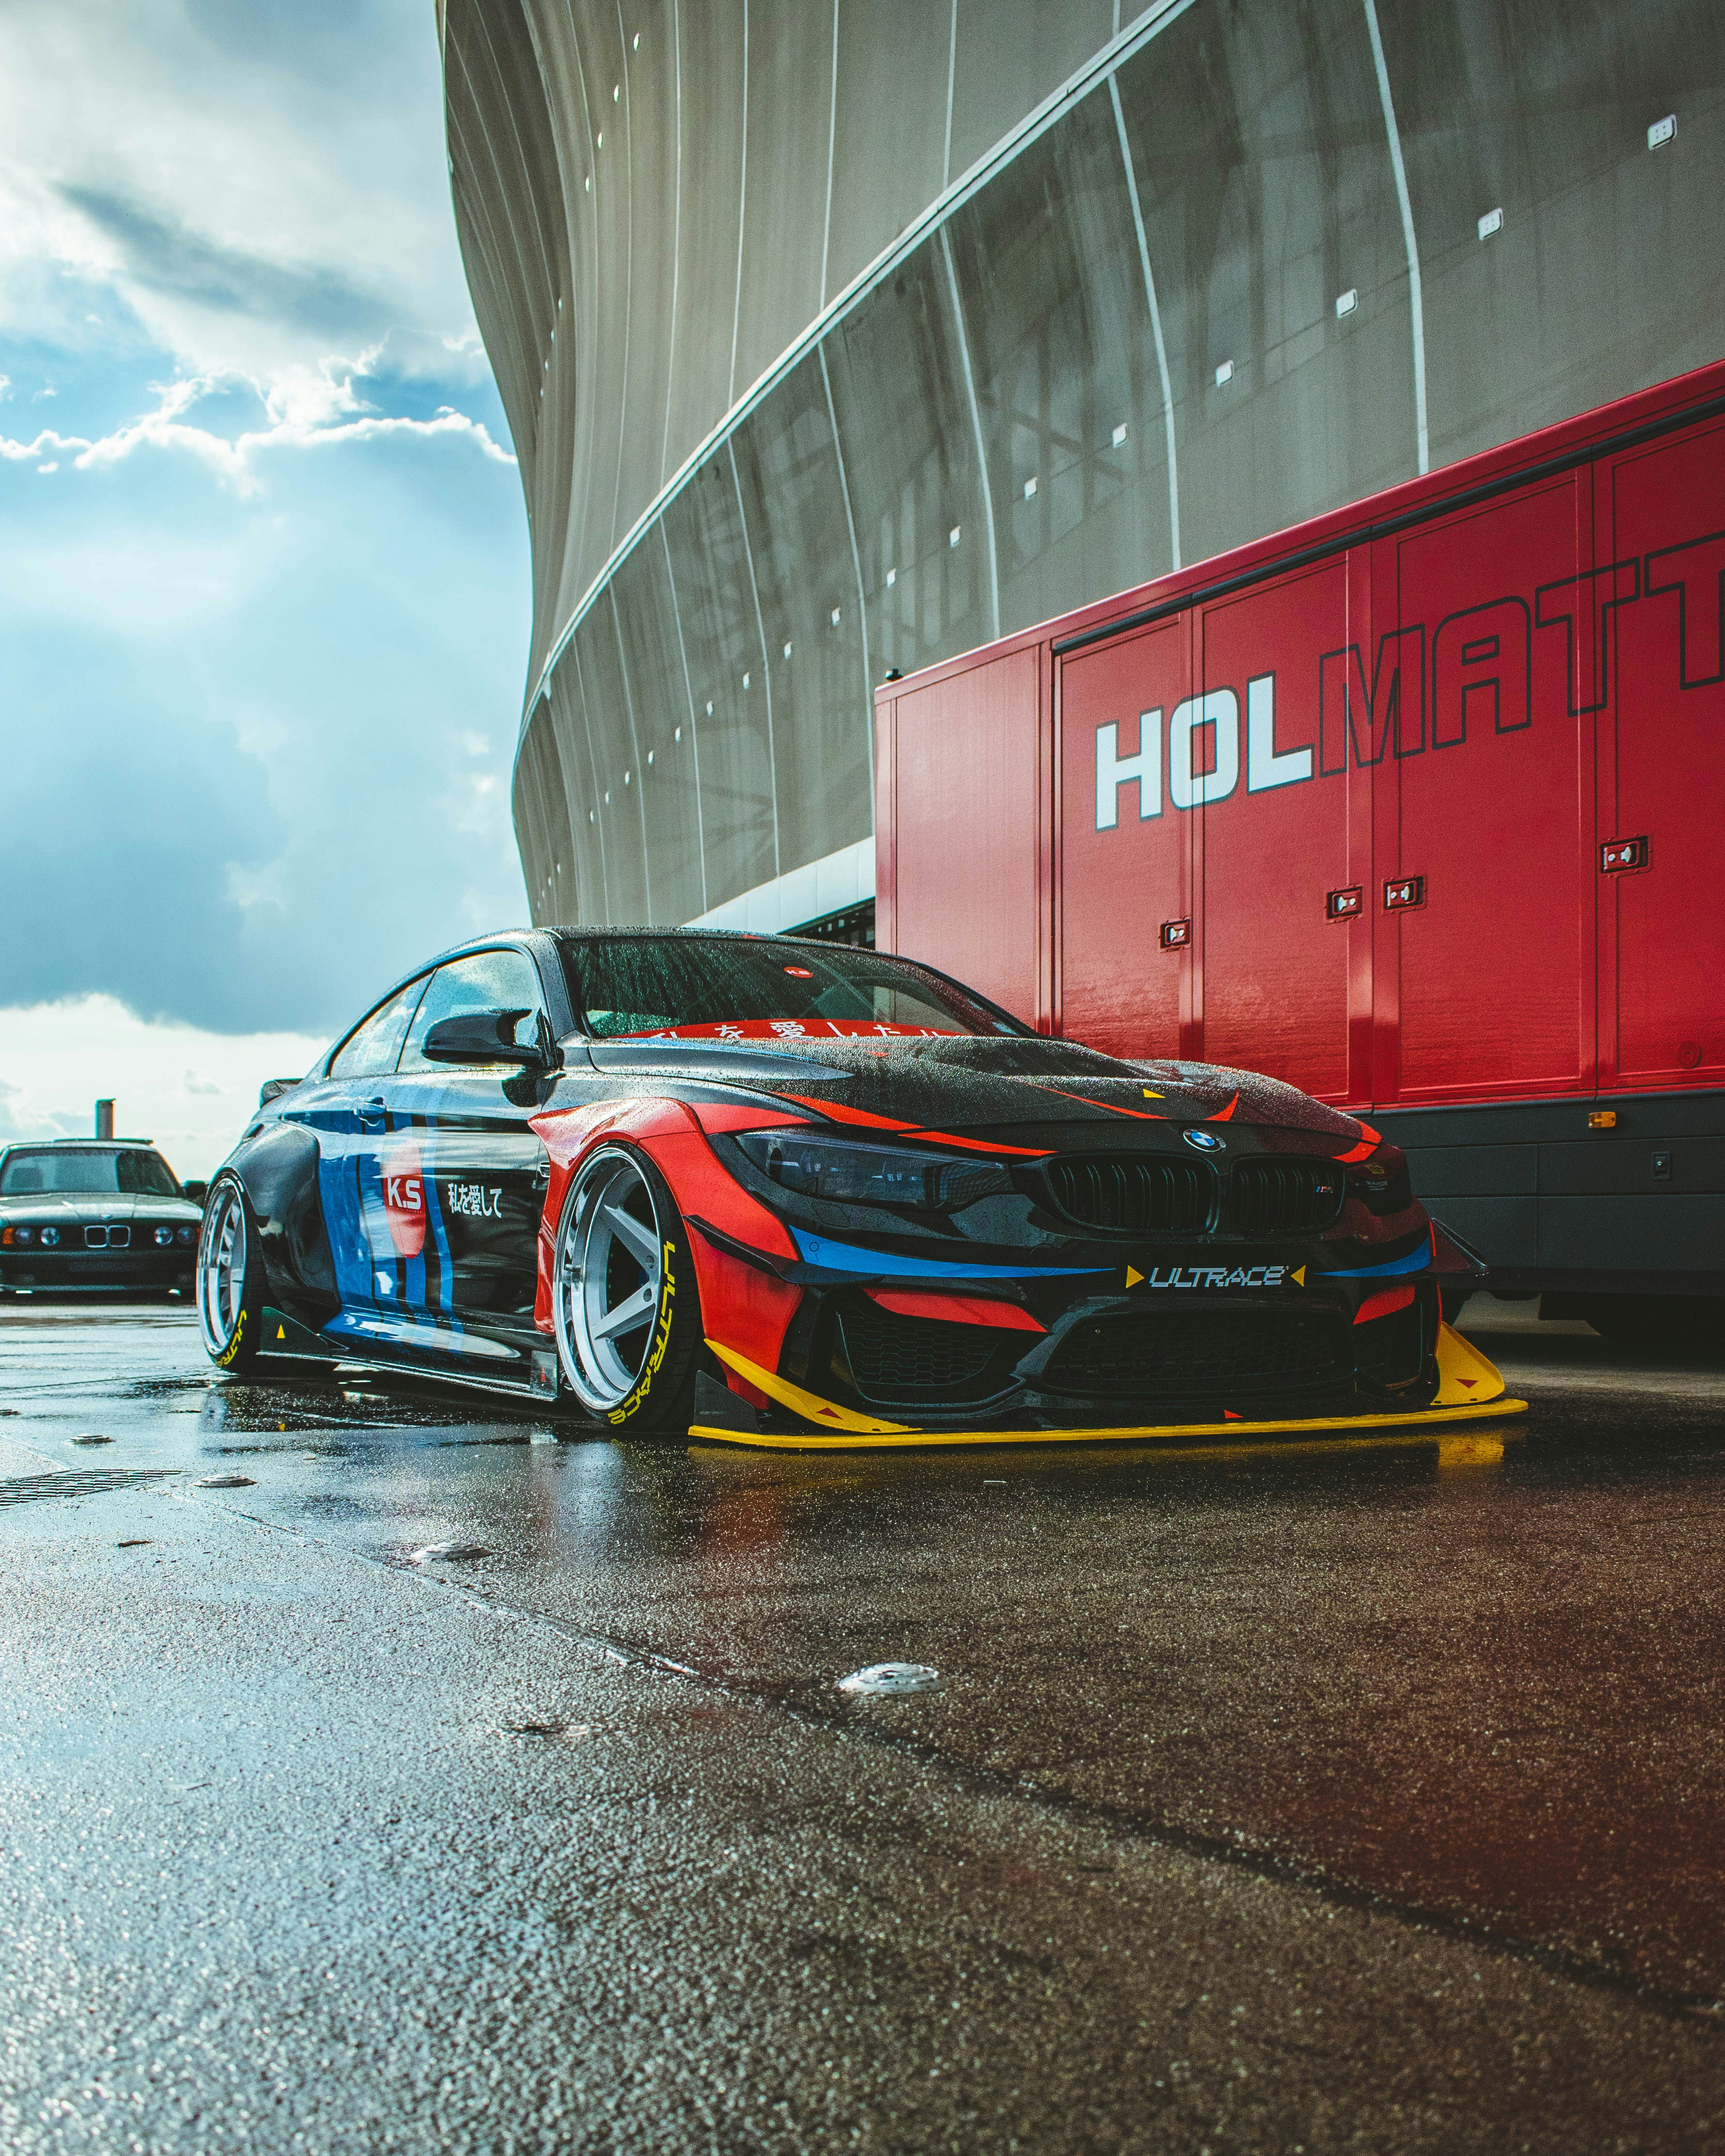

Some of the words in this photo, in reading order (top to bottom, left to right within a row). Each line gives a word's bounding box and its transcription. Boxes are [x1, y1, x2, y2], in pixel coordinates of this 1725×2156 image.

[447, 1183, 502, 1218] 私を愛して
[1149, 1266, 1285, 1287] ULTRACE
[607, 1241, 676, 1424] ULTRACE
